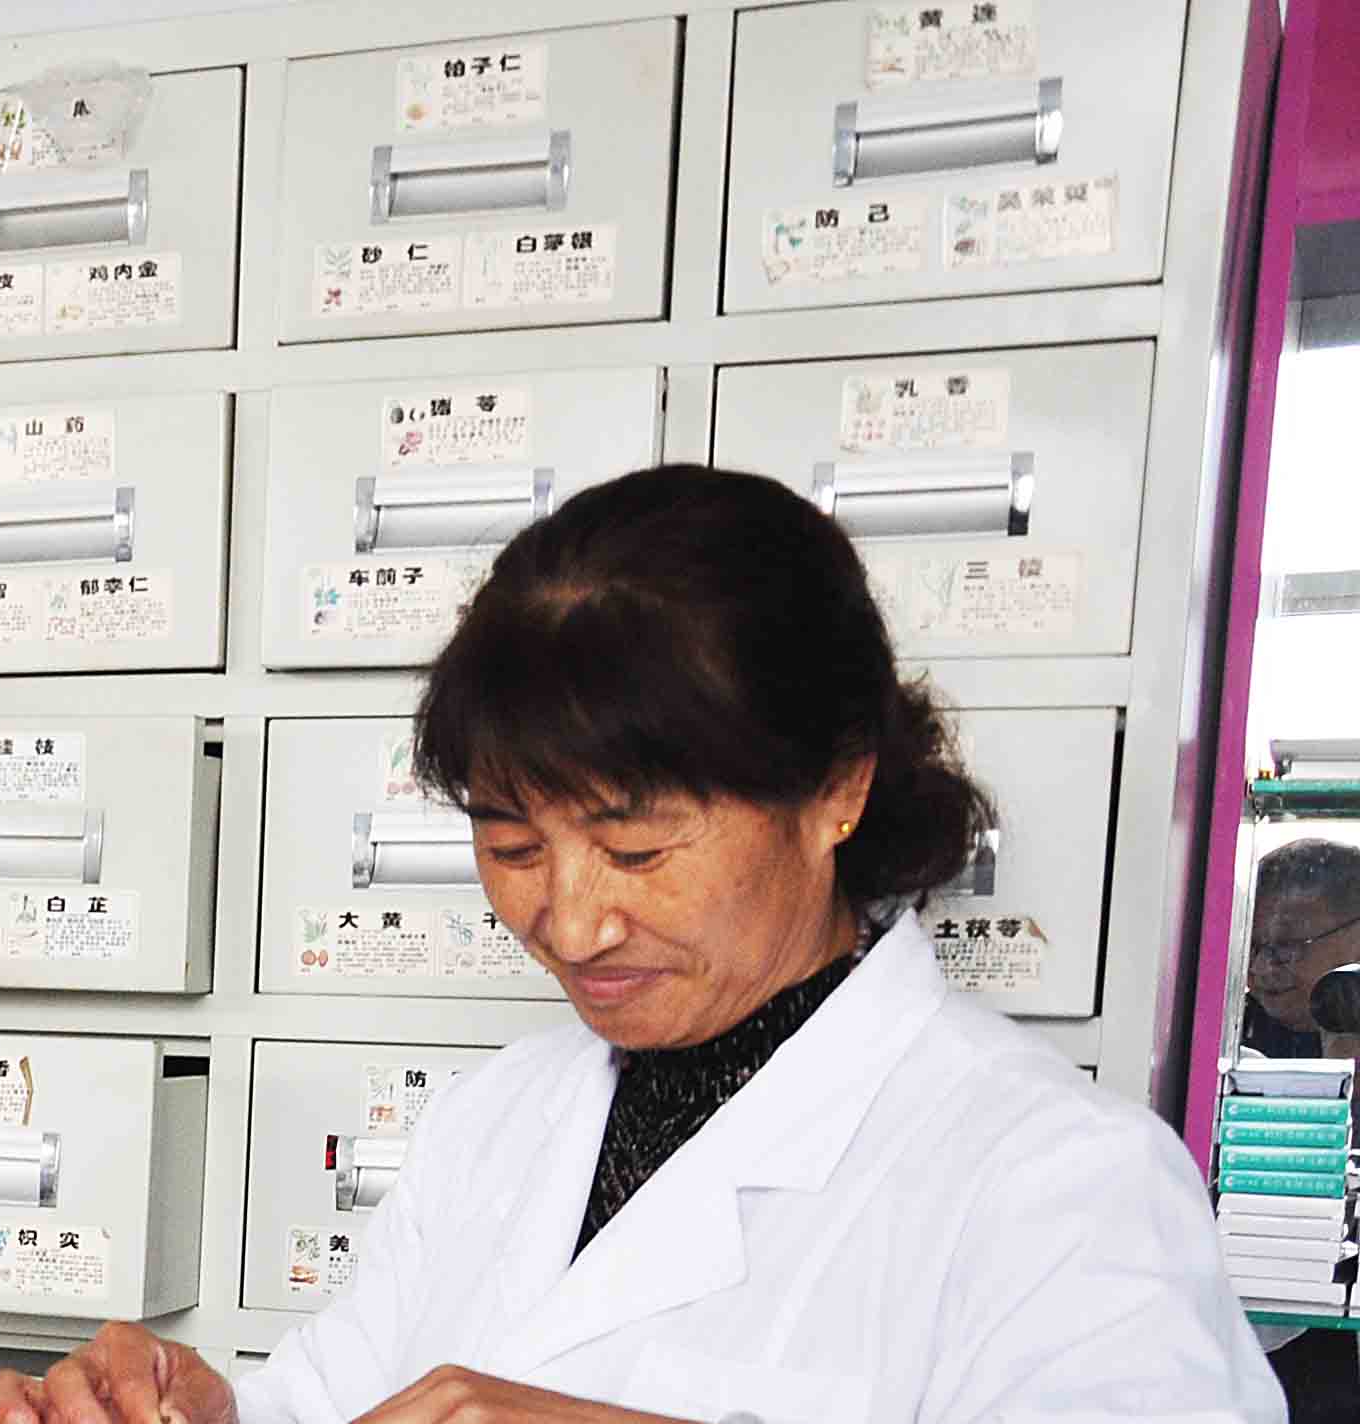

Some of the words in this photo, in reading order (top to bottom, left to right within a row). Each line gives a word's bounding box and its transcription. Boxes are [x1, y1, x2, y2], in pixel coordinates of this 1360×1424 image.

[444, 54, 520, 78] 柏子仁
[815, 204, 890, 228] 防己
[516, 231, 592, 253] 白茅根
[89, 261, 158, 281] 鸡内金
[25, 417, 84, 436] 山药
[80, 576, 148, 595] 郁李仁
[349, 567, 424, 586] 车前子
[47, 896, 108, 913] 白芷
[338, 911, 402, 929] 大黄
[934, 918, 1022, 939] 土茯苓
[18, 1229, 80, 1249] 枳实
